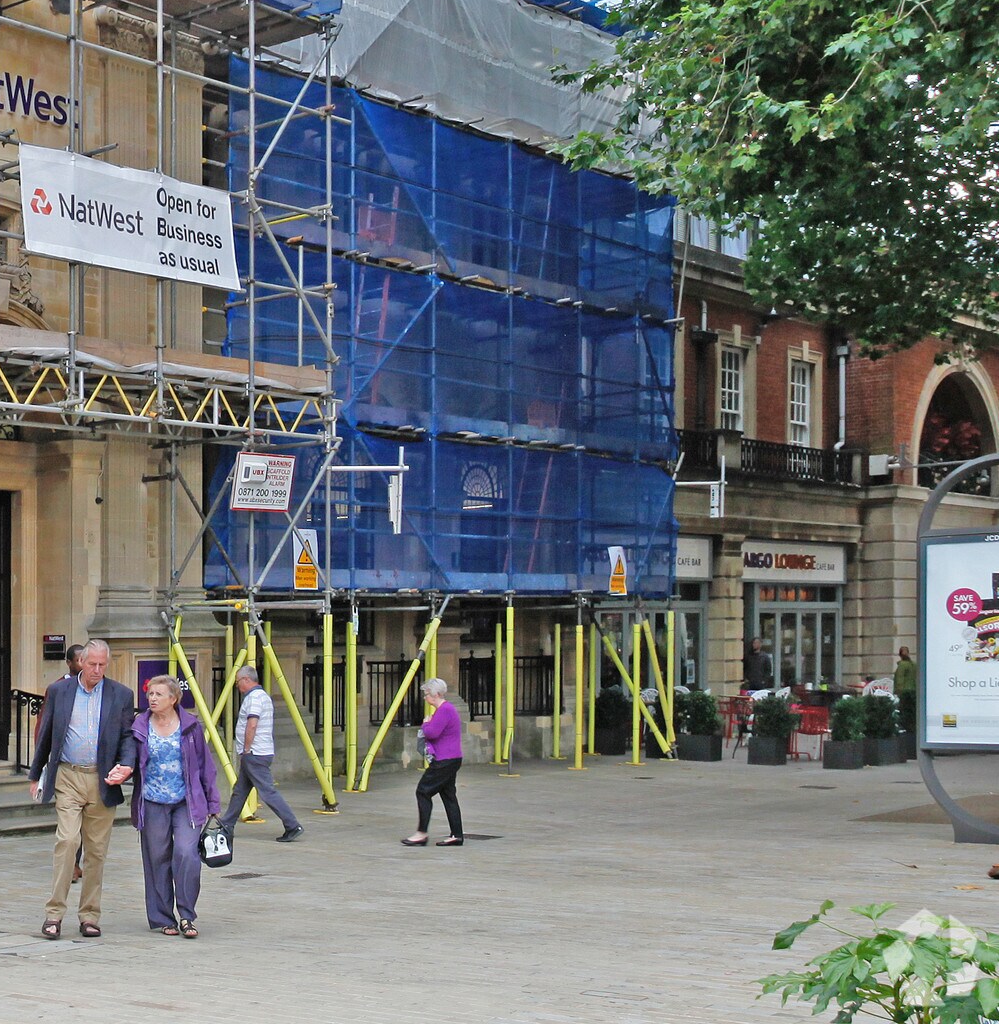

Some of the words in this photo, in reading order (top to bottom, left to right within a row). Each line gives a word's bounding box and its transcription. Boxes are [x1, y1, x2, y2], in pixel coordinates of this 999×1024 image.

[156, 187, 193, 215] Open
[197, 198, 217, 220] for
[58, 192, 144, 236] NatWest
[157, 217, 223, 250] Business
[159, 251, 176, 267] as
[180, 253, 220, 276] usual
[238, 487, 254, 496] 0871
[256, 488, 270, 497] 200
[271, 489, 287, 498] 1999
[743, 551, 774, 569] ARGO
[953, 594, 974, 602] SAVE
[952, 601, 978, 615] 59%
[948, 677, 977, 690] Shop
[978, 680, 987, 688] a
